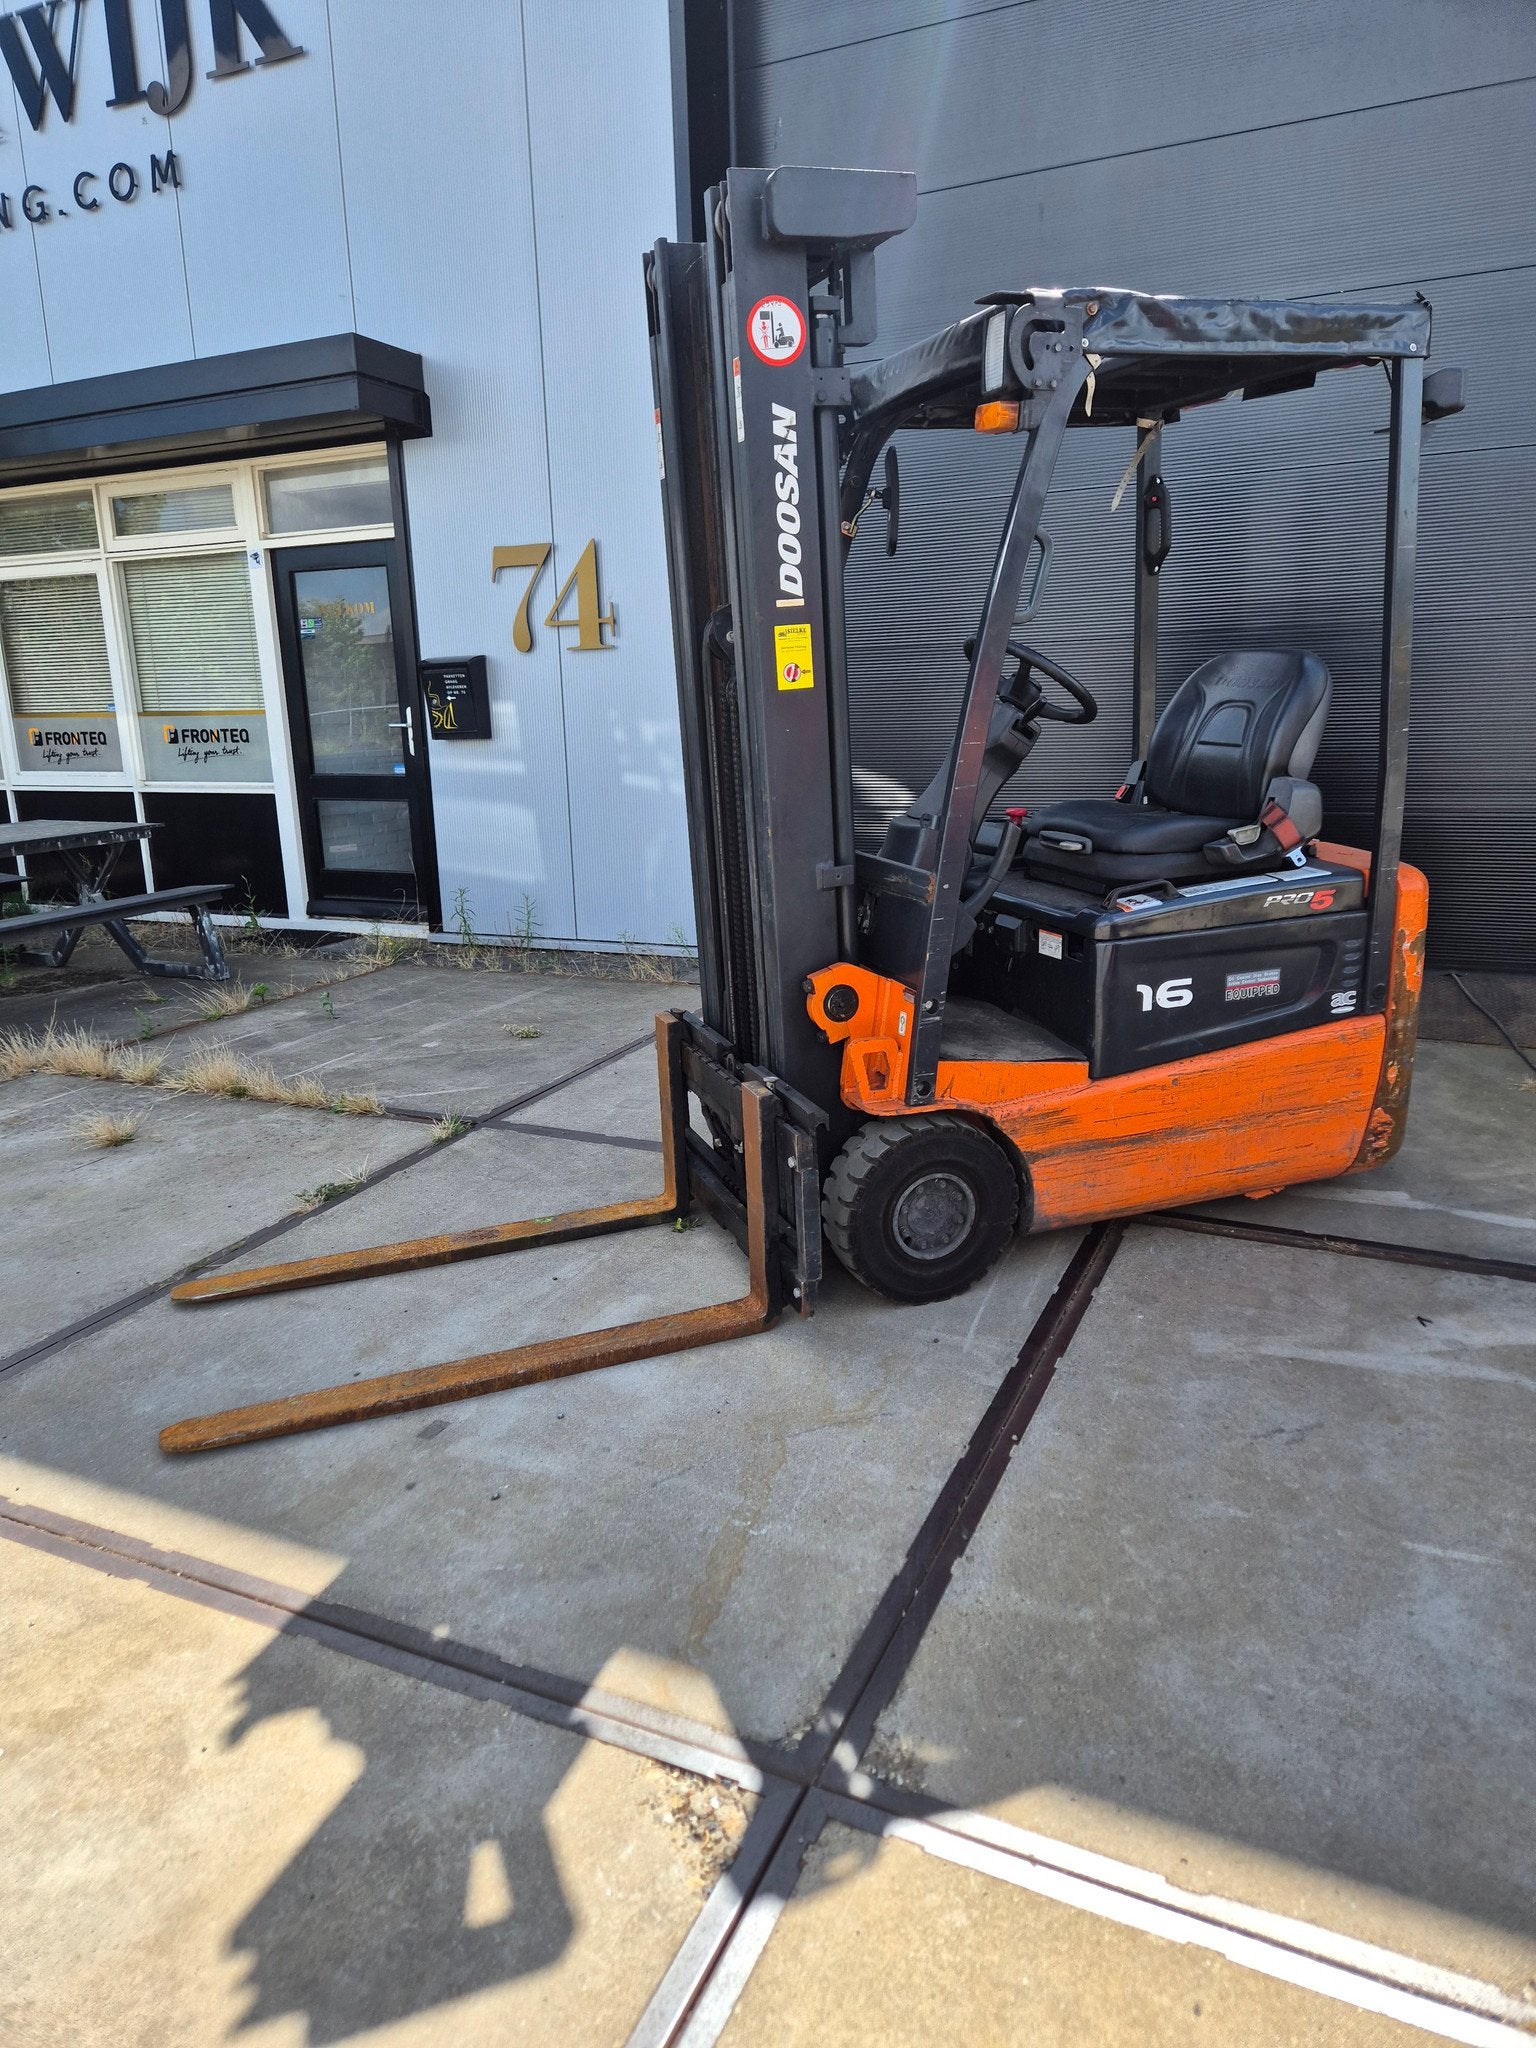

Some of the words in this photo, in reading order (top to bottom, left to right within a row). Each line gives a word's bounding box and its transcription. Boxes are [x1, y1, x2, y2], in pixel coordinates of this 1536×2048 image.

[772, 402, 804, 597] DOOSAN
[490, 537, 616, 653] 74
[44, 731, 107, 746] FRONTEQ
[181, 728, 250, 744] FRONTEQ
[42, 748, 62, 765] Lifting
[66, 751, 80, 764] your
[178, 746, 200, 764] Lifting
[204, 750, 219, 763] your
[1263, 889, 1336, 910] PRO5
[1136, 978, 1193, 1012] 16
[1225, 983, 1280, 1001] EQUIPPED
[1331, 990, 1357, 1008] ac
